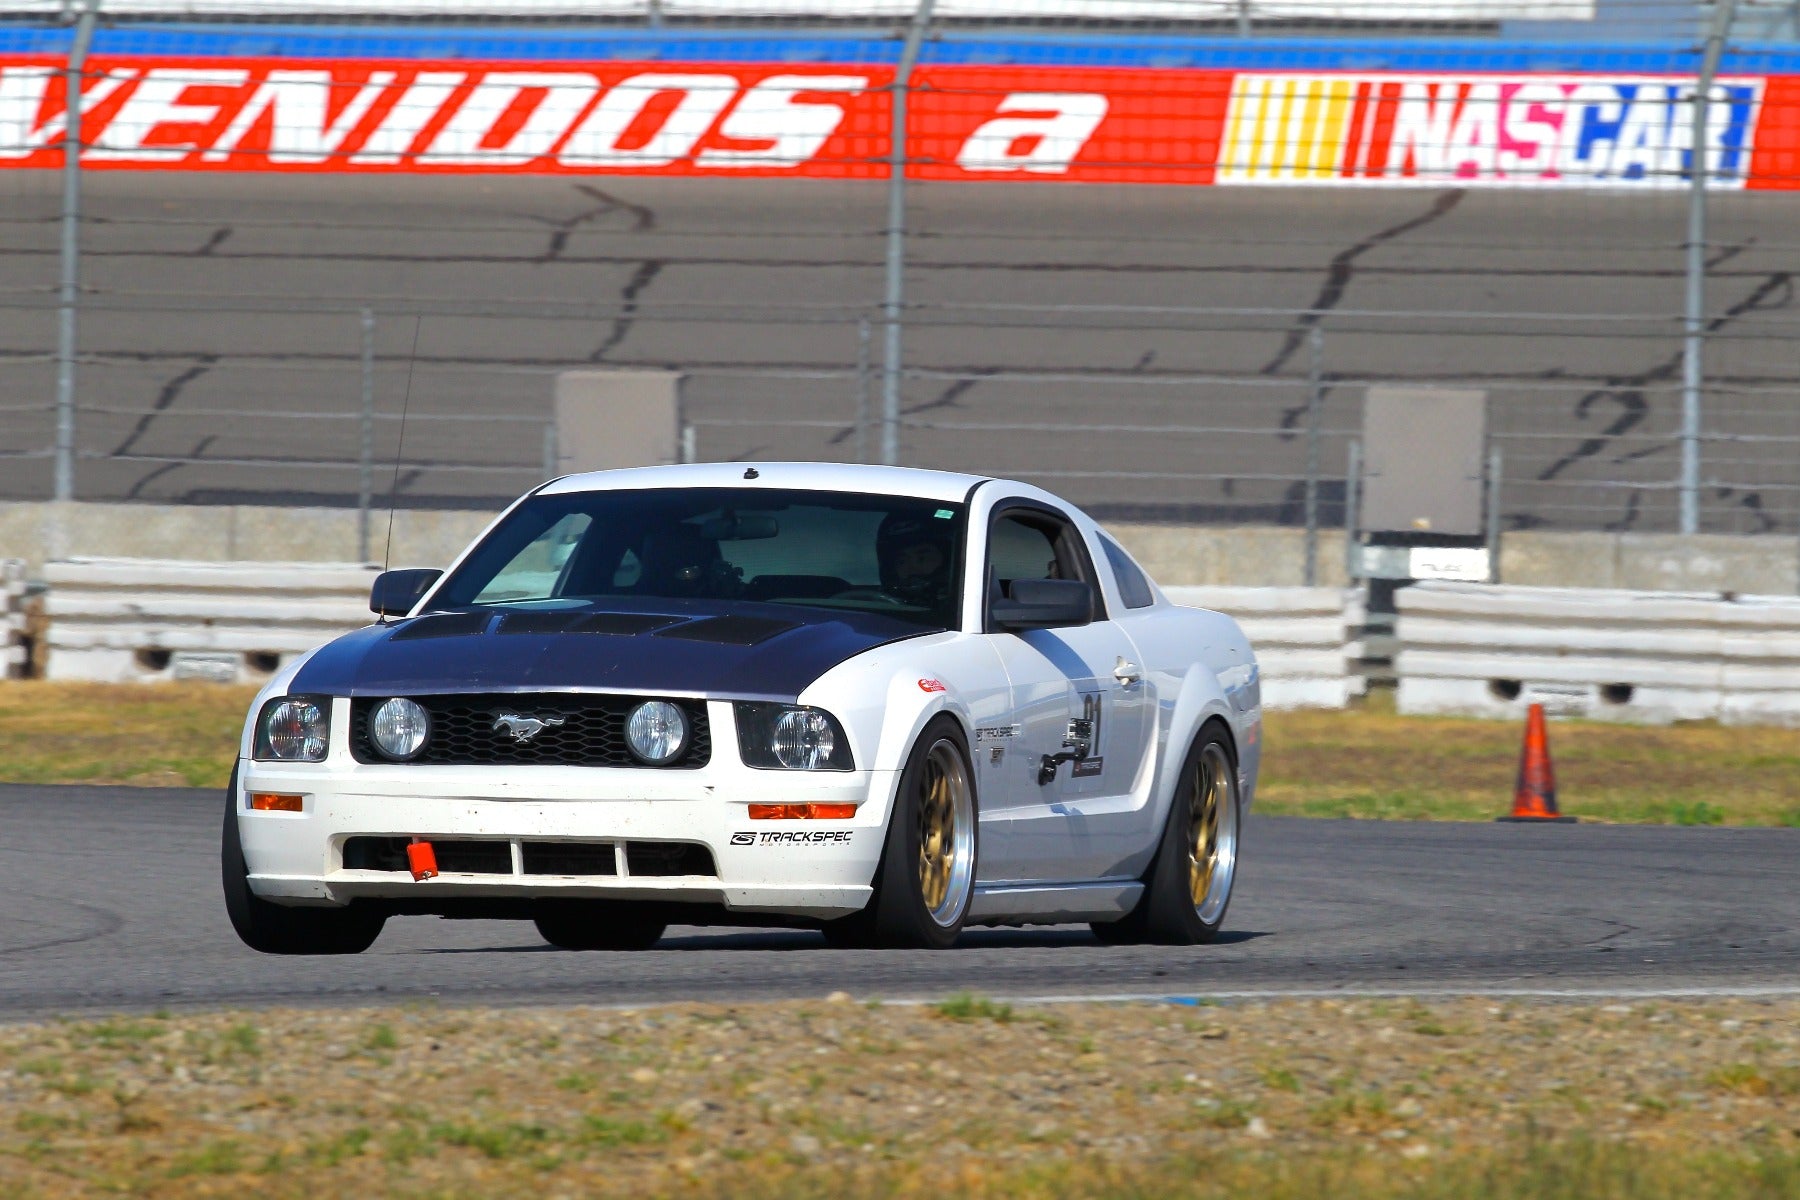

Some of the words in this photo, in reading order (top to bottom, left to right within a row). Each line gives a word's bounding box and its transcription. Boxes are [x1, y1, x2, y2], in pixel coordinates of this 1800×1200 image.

[0, 66, 868, 169] VENIDOS
[956, 92, 1109, 174] a
[1386, 81, 1731, 181] NASCAR
[759, 831, 854, 842] TRACKSPEC
